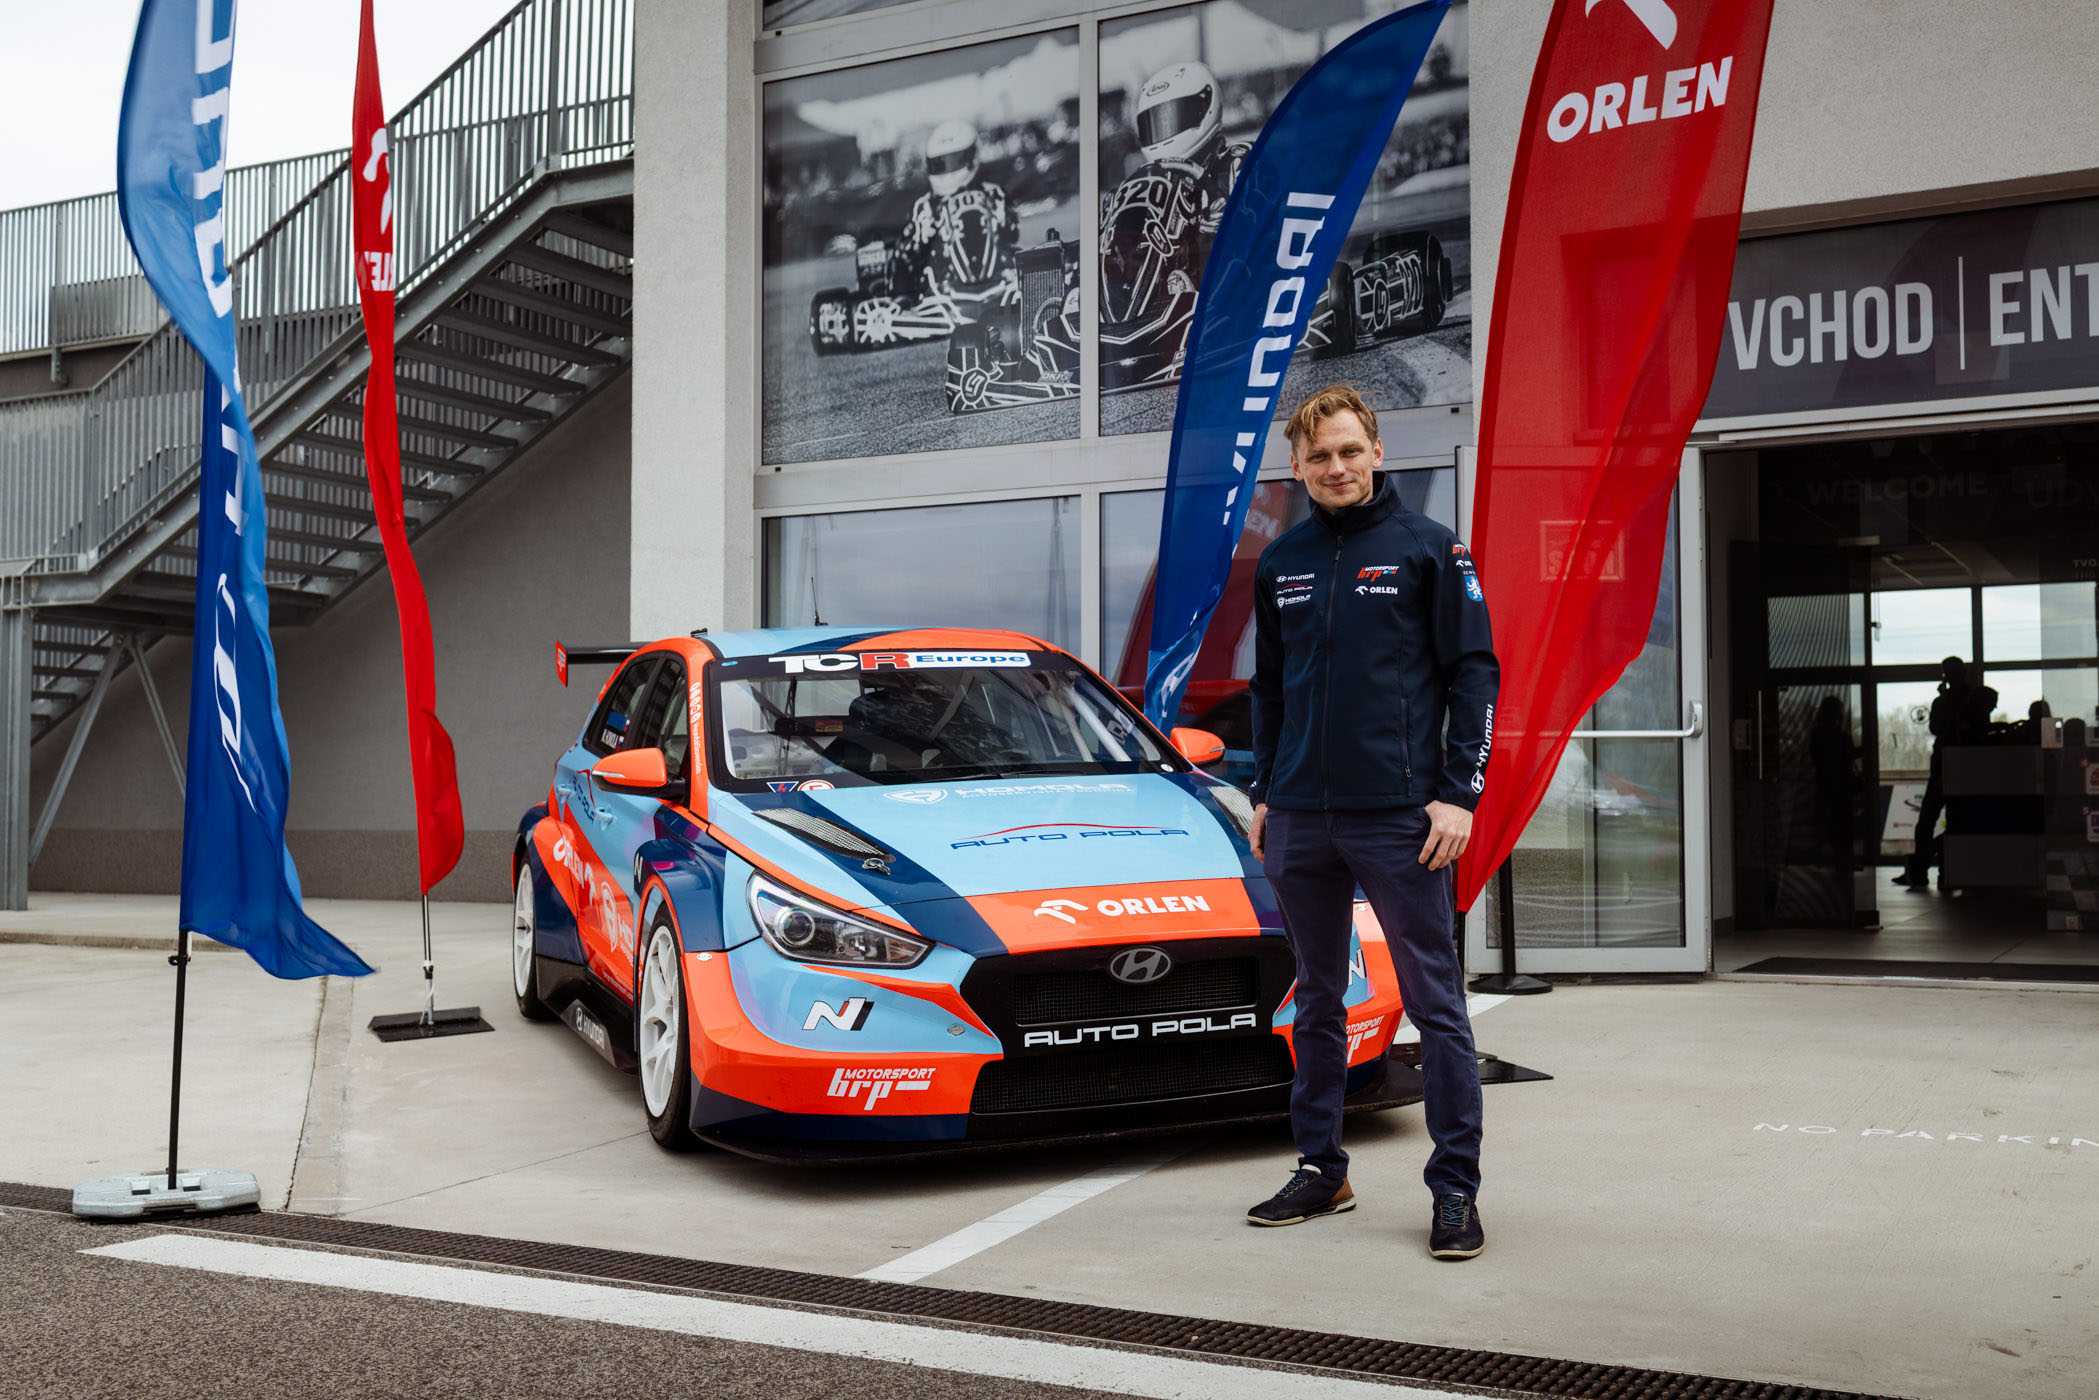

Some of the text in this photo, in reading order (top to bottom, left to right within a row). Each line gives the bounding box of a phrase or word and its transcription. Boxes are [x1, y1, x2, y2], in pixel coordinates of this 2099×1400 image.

[1547, 56, 1733, 143] ORLEN
[1117, 180, 1169, 208] 320
[1728, 281, 1933, 370] VCHOD
[1287, 573, 1315, 581] HYUNDAI
[1357, 567, 1383, 582] brp
[1369, 586, 1398, 595] ORLEN
[768, 652, 1025, 674] TCR Europe
[1476, 704, 1494, 768] HYUNDAI
[950, 829, 1189, 850] AUTO POLA
[1097, 895, 1211, 916] ORLEN
[1024, 1013, 1256, 1047] AUTO POLA
[1346, 1016, 1384, 1034] OTORSPORT
[844, 1068, 936, 1080] MOTORSPORT
[827, 1068, 893, 1110] brp
[1753, 1123, 2099, 1147] NO PARKIN
